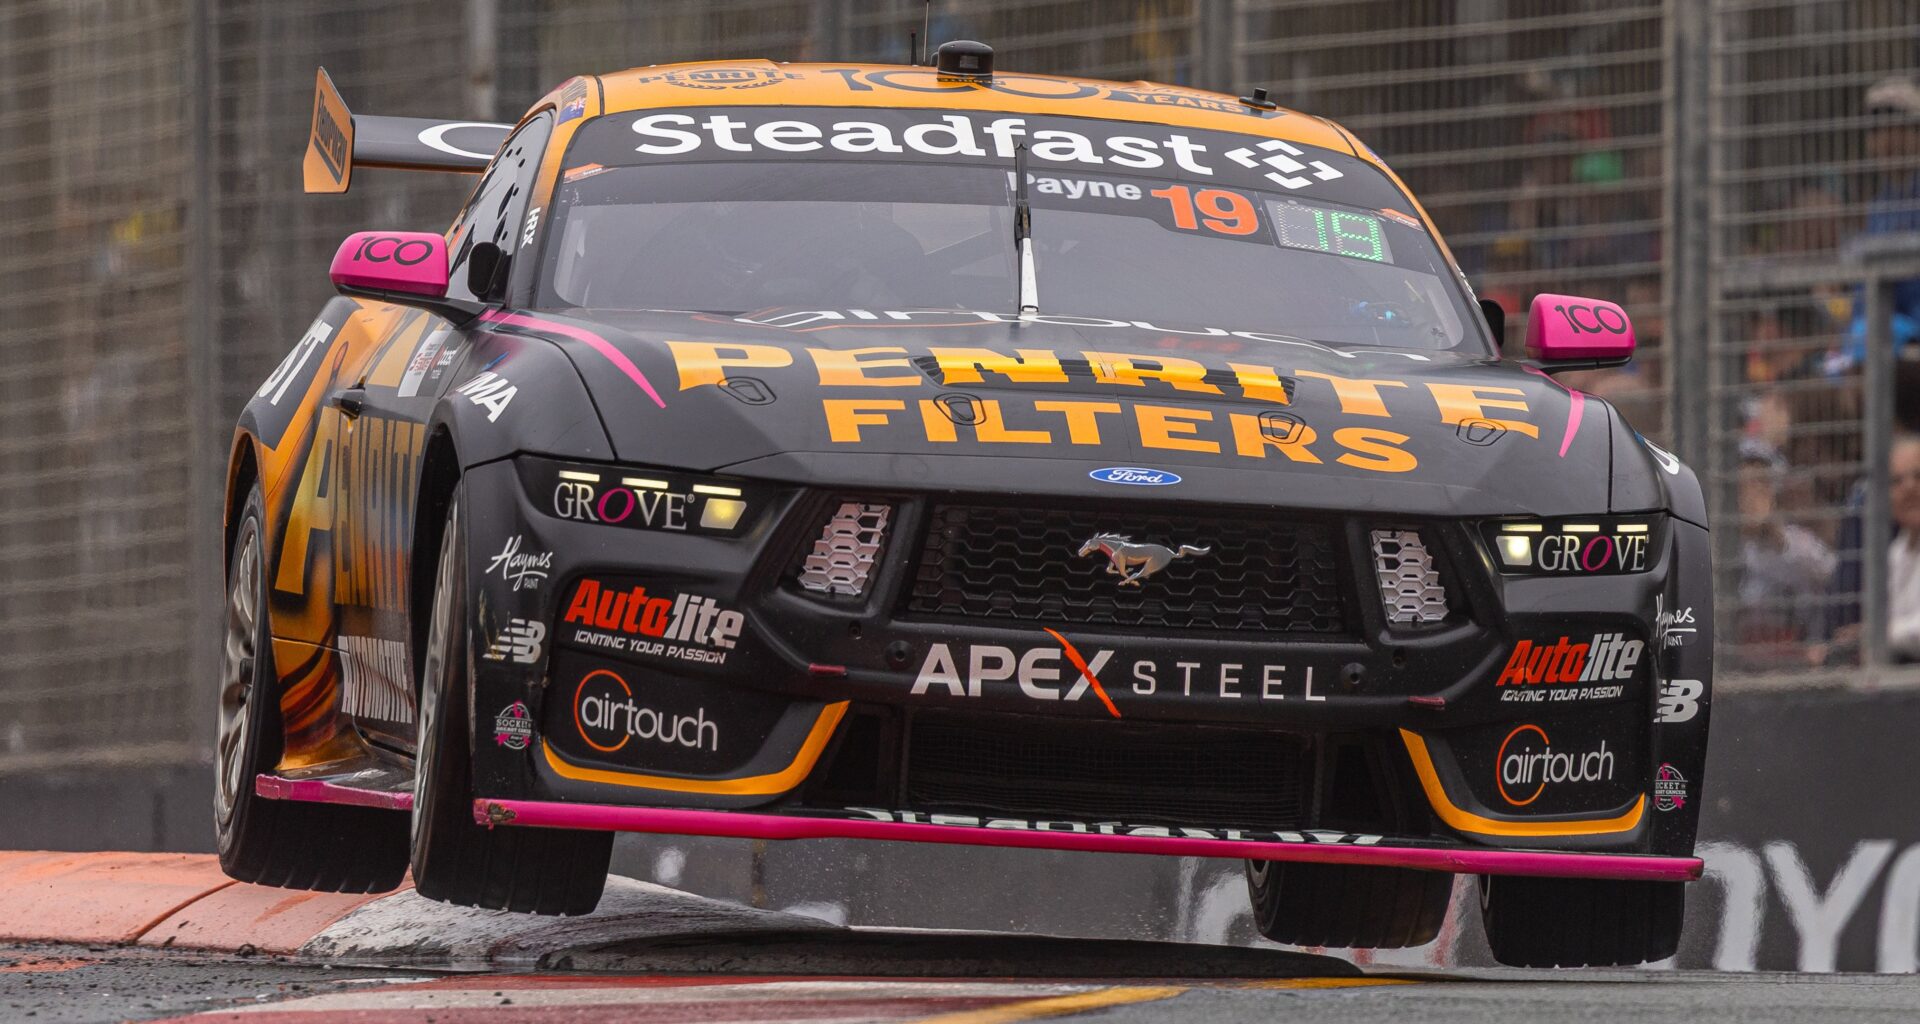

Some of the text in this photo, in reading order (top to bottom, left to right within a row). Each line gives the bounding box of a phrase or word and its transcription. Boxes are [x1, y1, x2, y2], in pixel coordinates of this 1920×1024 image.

[638, 69, 806, 84] PENRITE
[1129, 94, 1244, 113] YEARS
[631, 113, 1213, 176] Steadfast
[1151, 185, 1259, 236] 19
[352, 236, 434, 266] 100
[1554, 304, 1628, 335] 100
[663, 340, 1539, 440] PENRITE
[822, 399, 1418, 473] FILTERS
[1108, 469, 1163, 483] Ford
[554, 482, 687, 530] GROVE
[485, 535, 553, 591] Haymes
[1538, 535, 1646, 572] GROVE
[564, 579, 744, 649] Autolite
[574, 630, 726, 664] IGNITING YOUR PASSION
[1496, 633, 1645, 686] Autolite
[911, 627, 1326, 718] APEX STEEL
[1500, 685, 1624, 702] IGNITING YOUR PASSION
[581, 692, 719, 752] airtouch
[1503, 739, 1614, 785] airtouch
